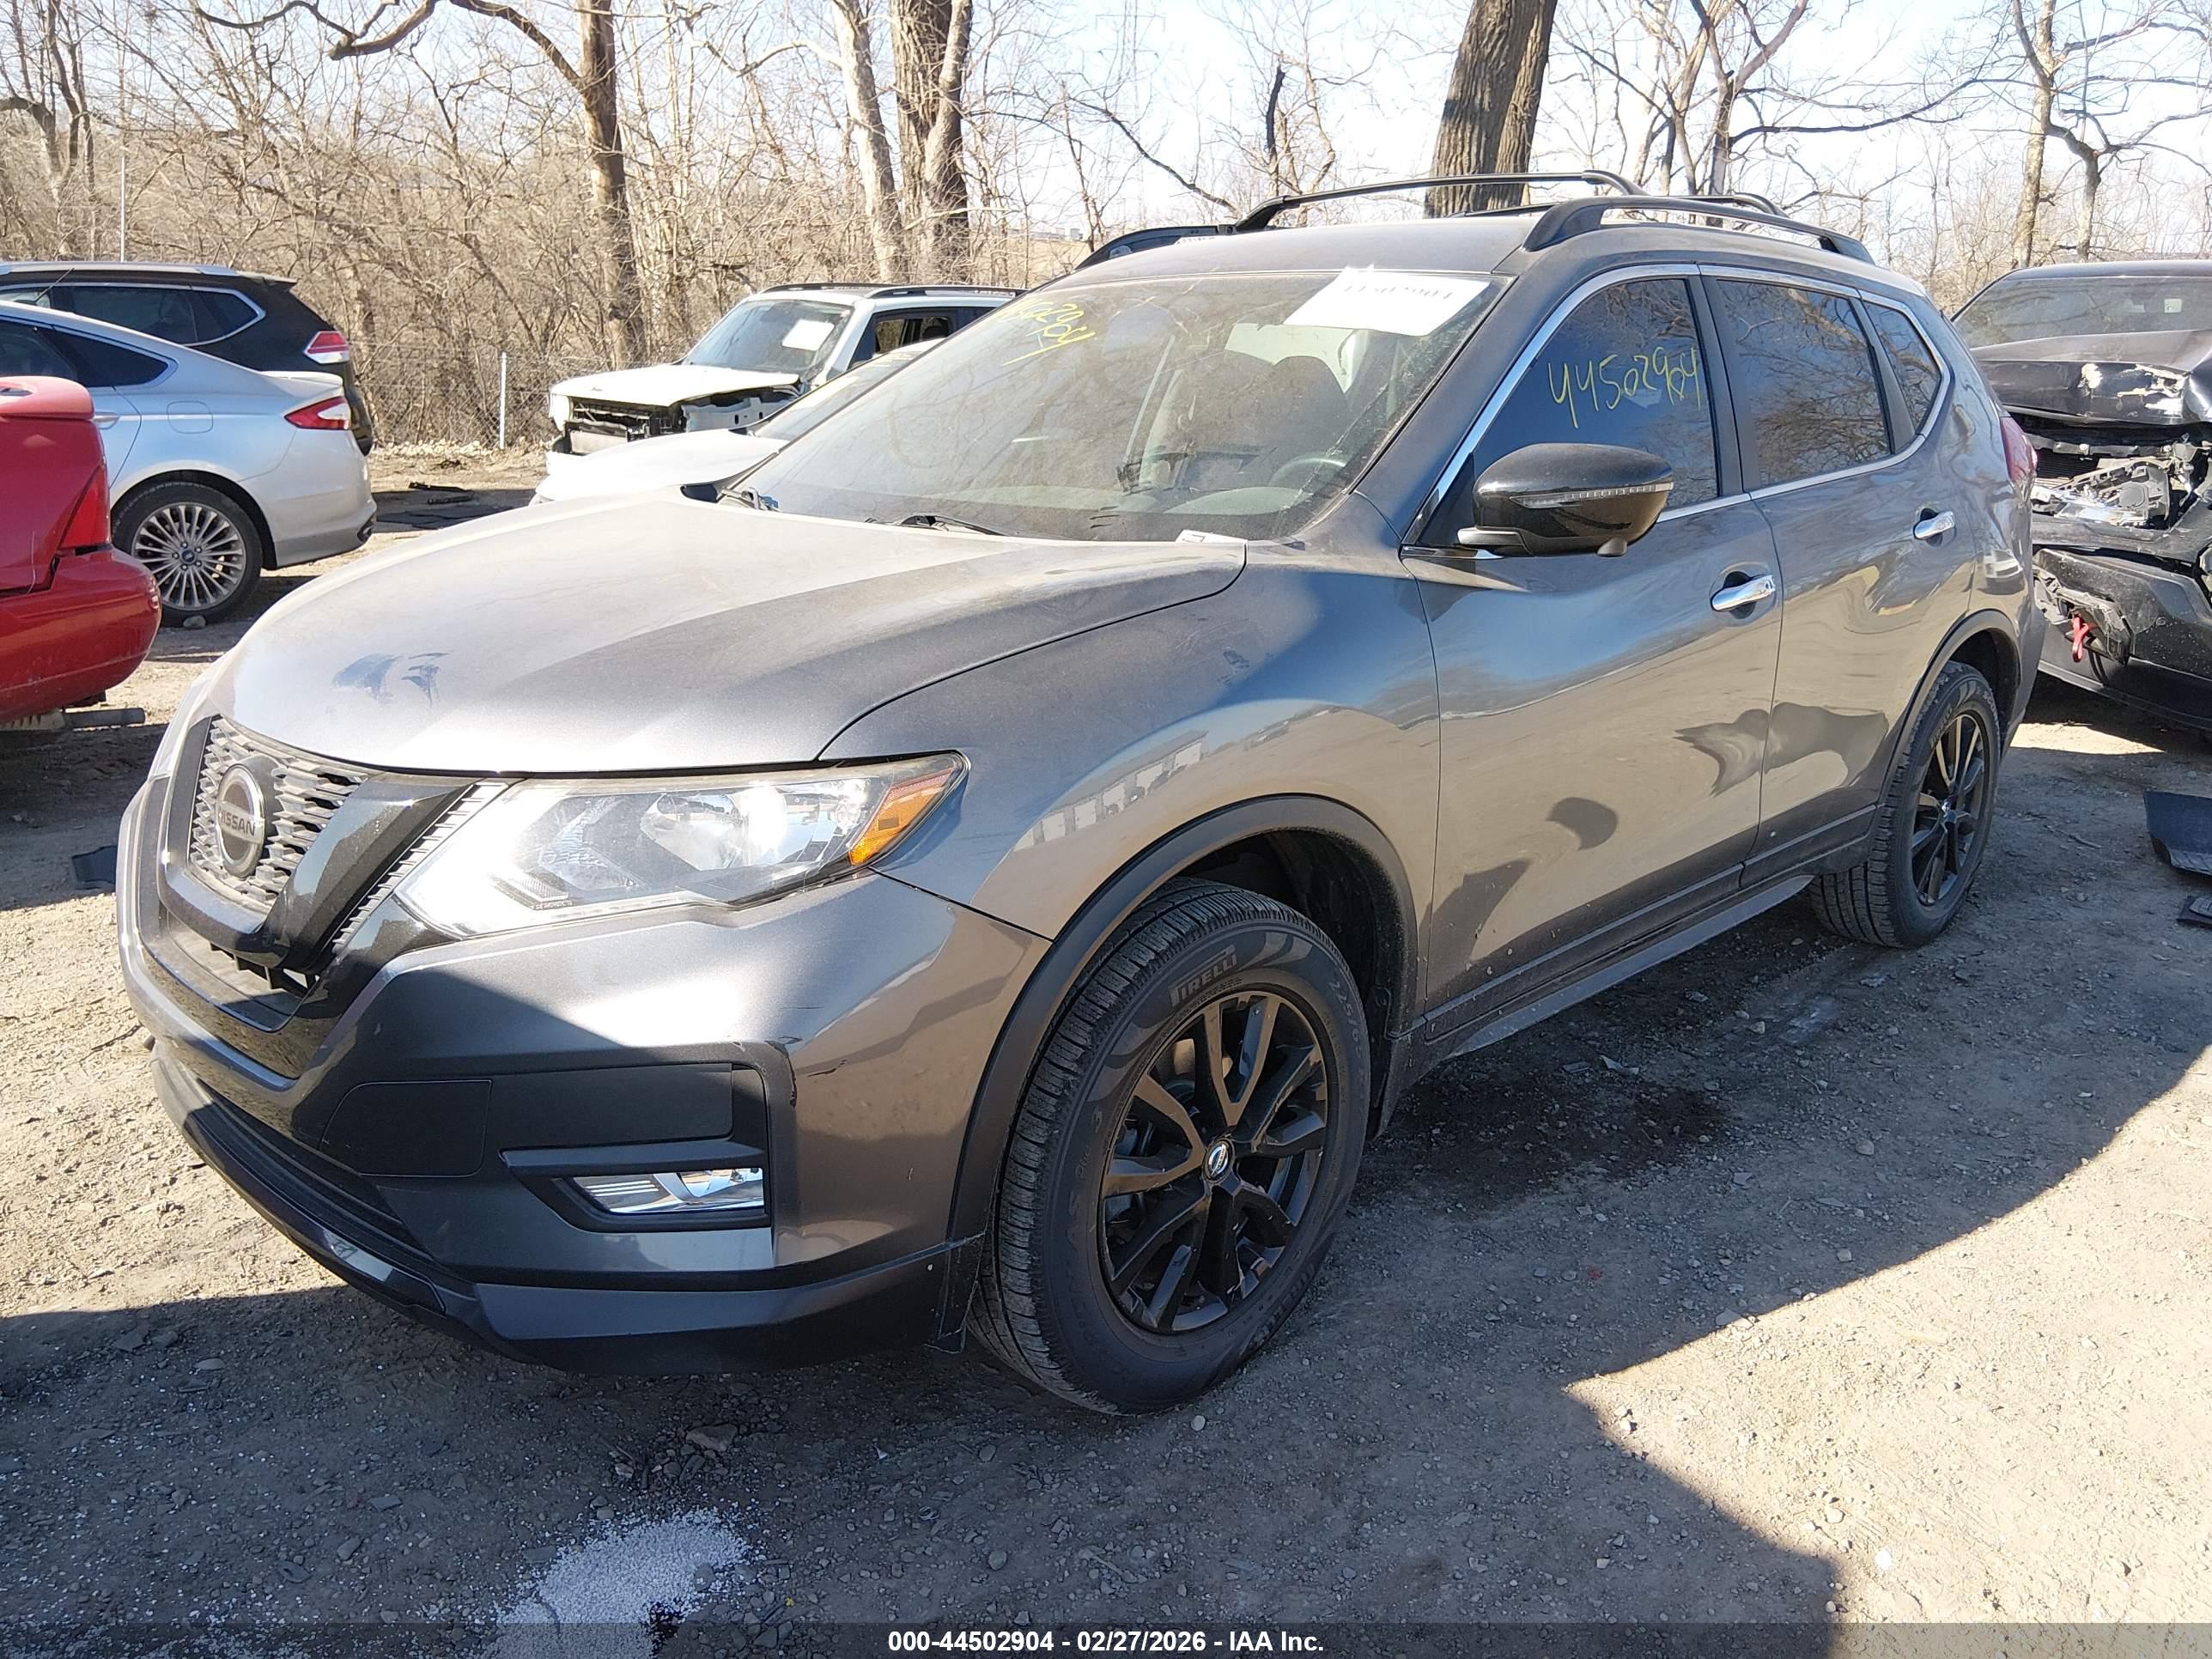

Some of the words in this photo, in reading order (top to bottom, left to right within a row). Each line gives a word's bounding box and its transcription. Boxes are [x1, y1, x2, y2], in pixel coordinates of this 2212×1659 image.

[1548, 345, 1701, 428] 44502904
[218, 806, 256, 836] NISSAN
[1169, 945, 1237, 1007] PIRELLI
